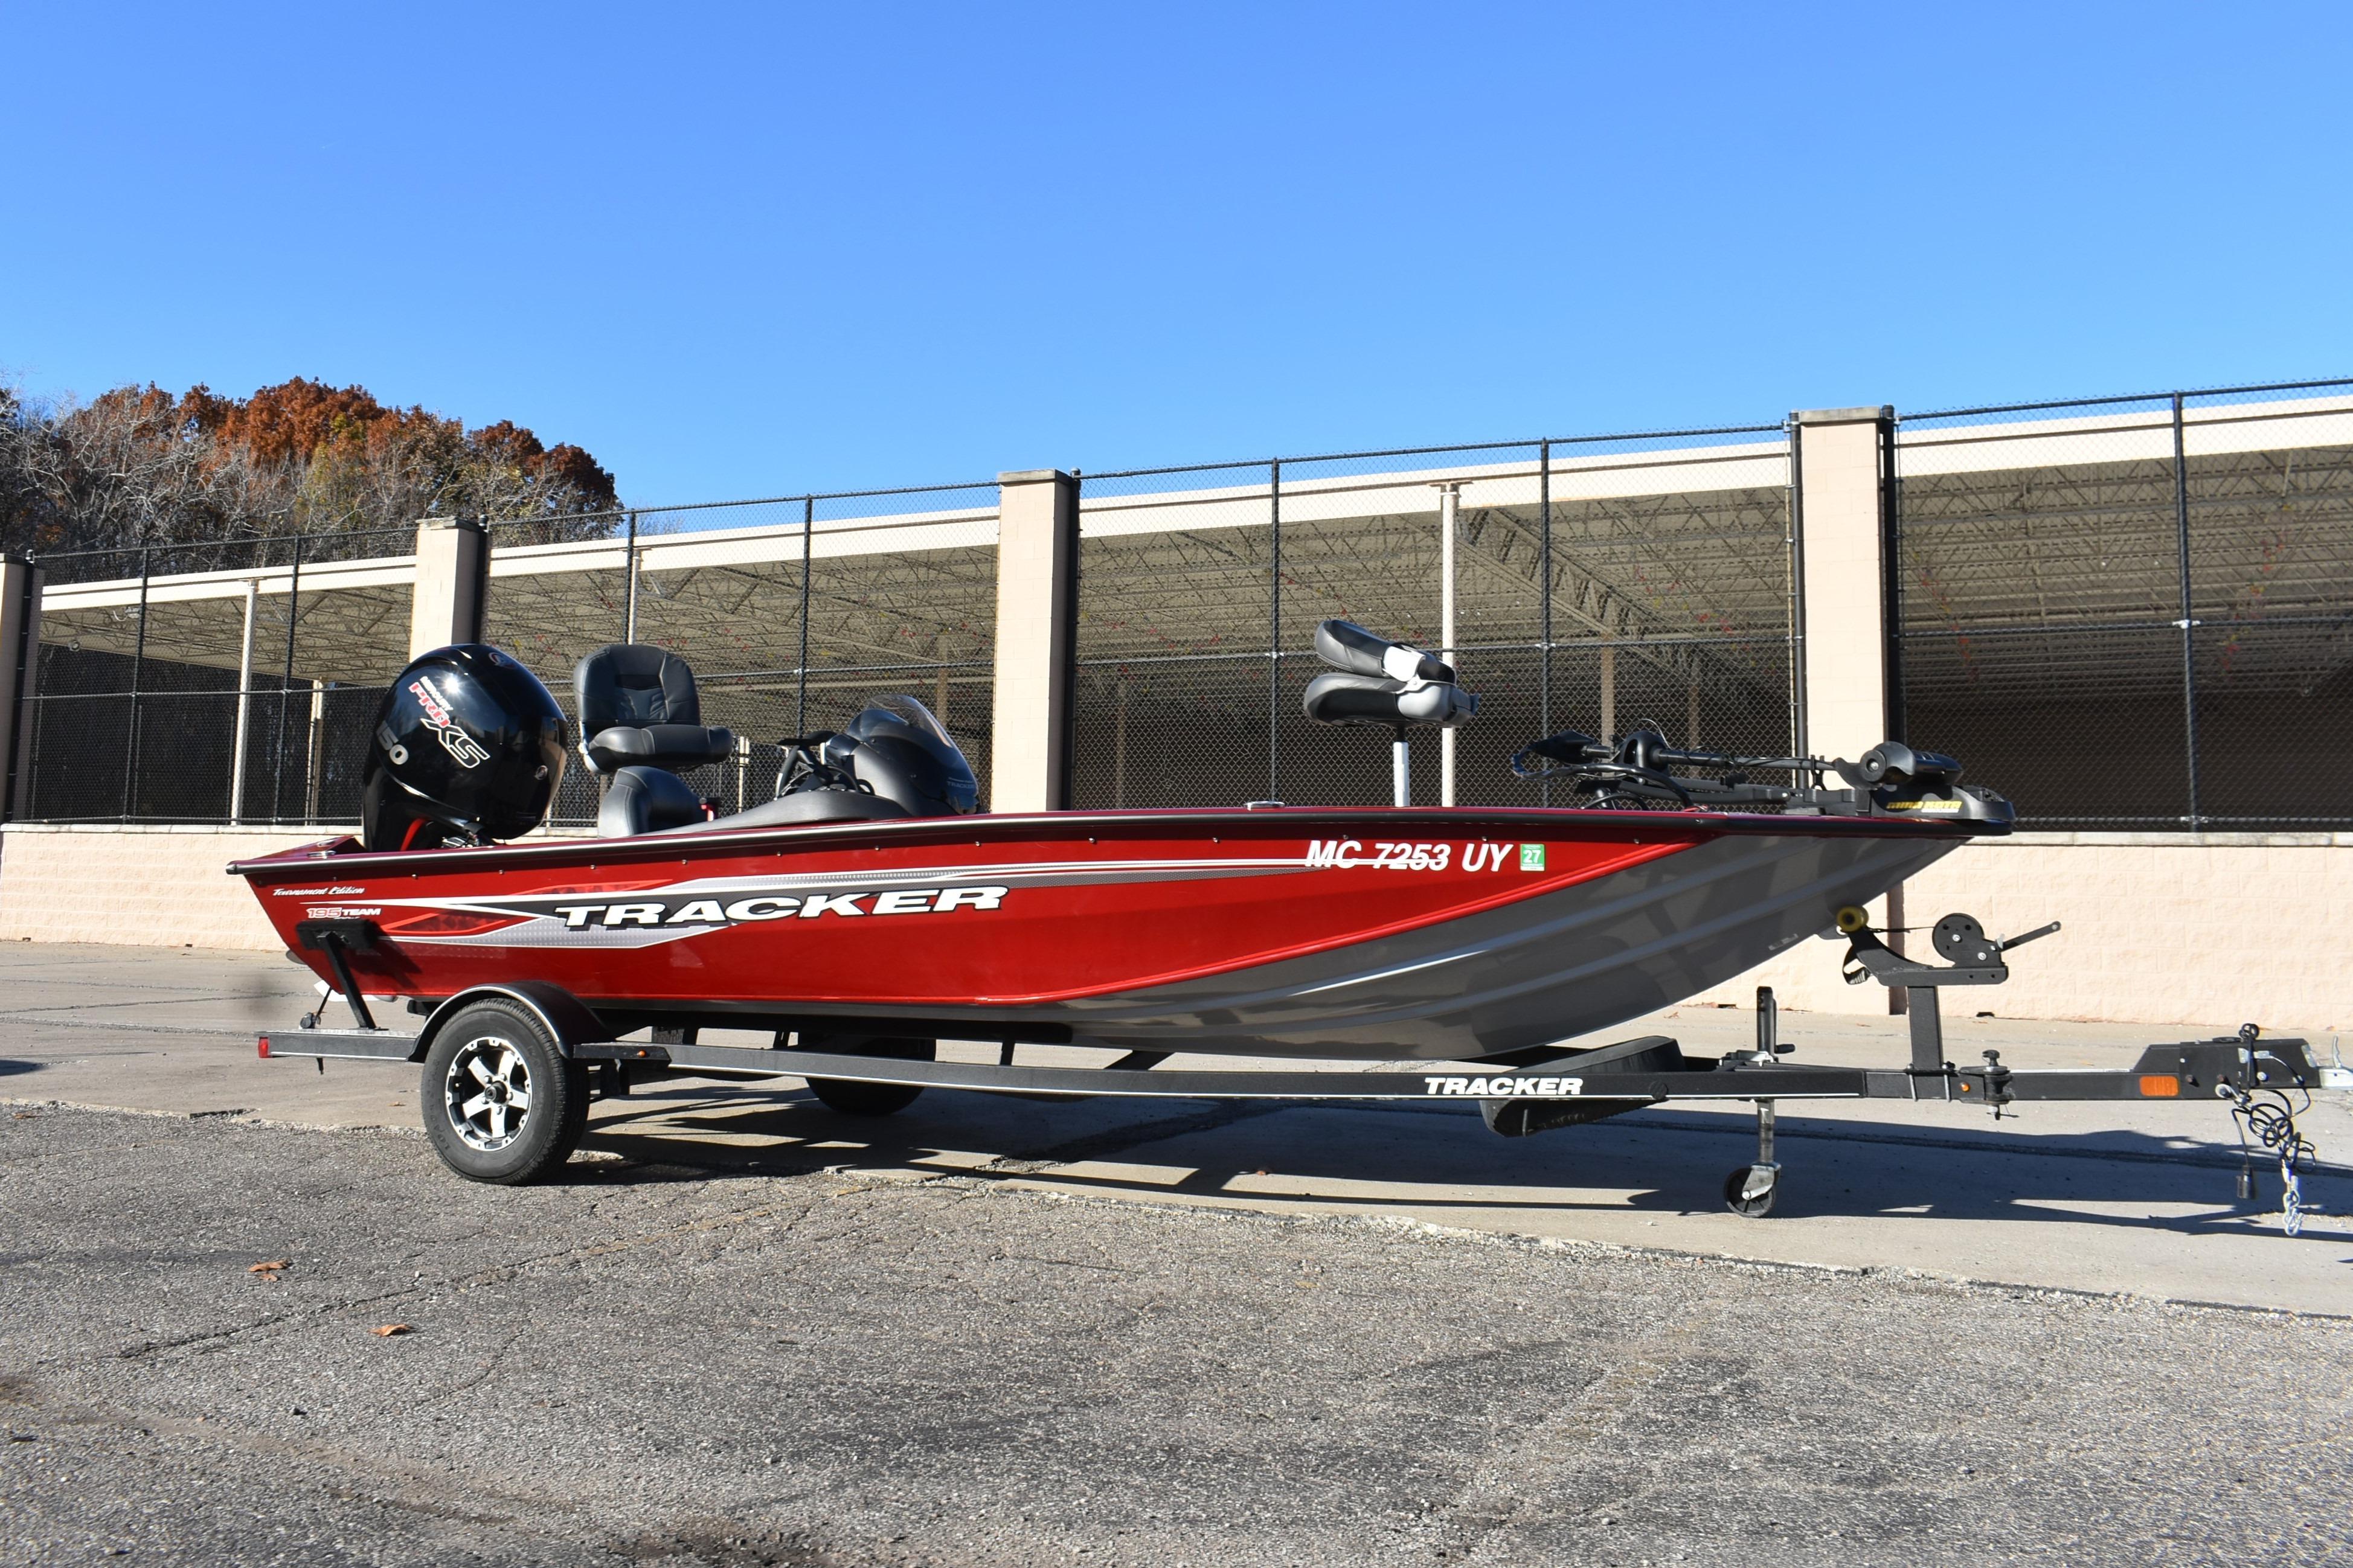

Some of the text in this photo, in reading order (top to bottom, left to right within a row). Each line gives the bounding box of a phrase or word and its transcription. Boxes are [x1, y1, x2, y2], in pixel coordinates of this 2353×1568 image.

[408, 682, 451, 728] PRO
[376, 720, 409, 765] 150
[420, 718, 490, 768] XS
[1305, 840, 1514, 872] MC 7253 UY
[1523, 850, 1542, 863] 27
[273, 886, 365, 896] Tournament Edition
[554, 886, 1009, 927] TRACKER
[1425, 1077, 1584, 1095] TRACKER
